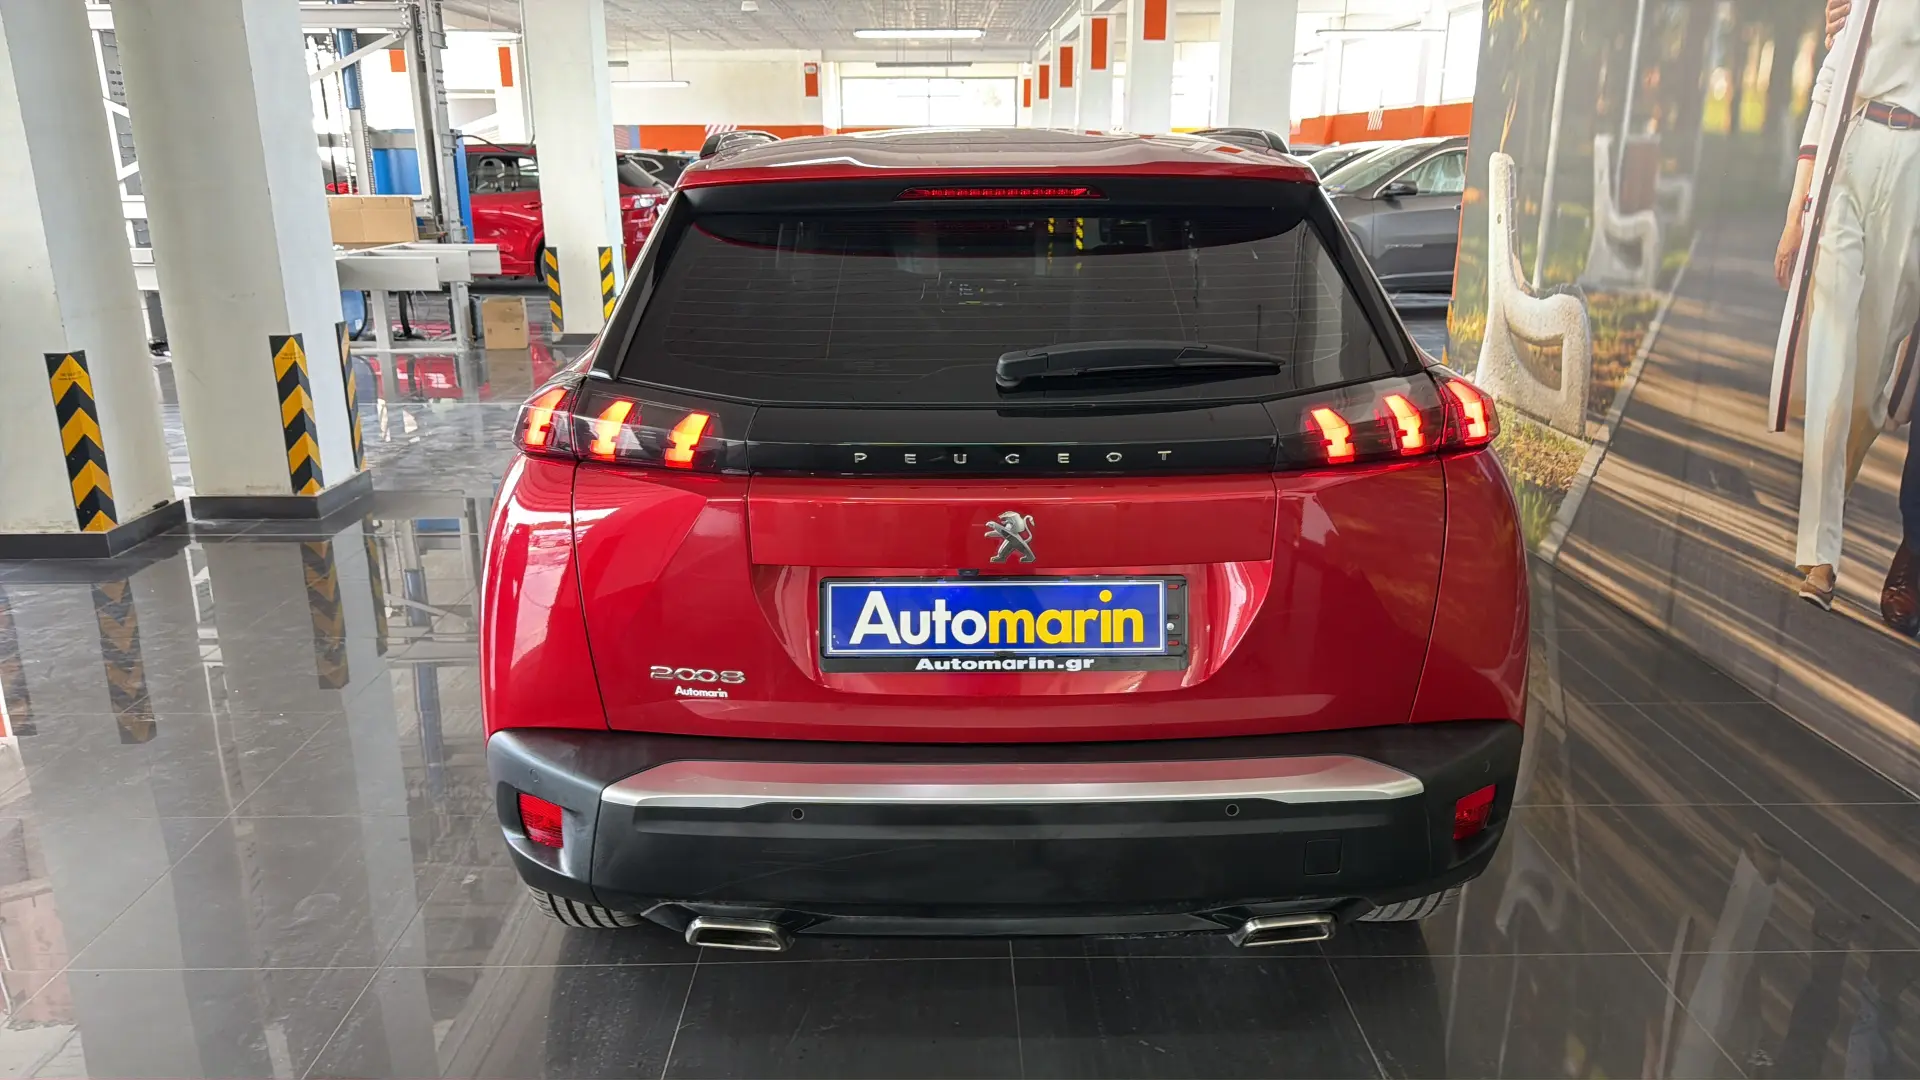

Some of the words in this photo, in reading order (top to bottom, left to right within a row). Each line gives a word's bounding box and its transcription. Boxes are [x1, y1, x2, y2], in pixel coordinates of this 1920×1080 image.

[853, 450, 1173, 464] PEUGEOT
[849, 589, 1145, 645] Automarin
[915, 657, 1095, 672] Automarin.gr
[651, 665, 746, 684] 2008
[674, 685, 729, 698] Automarin
